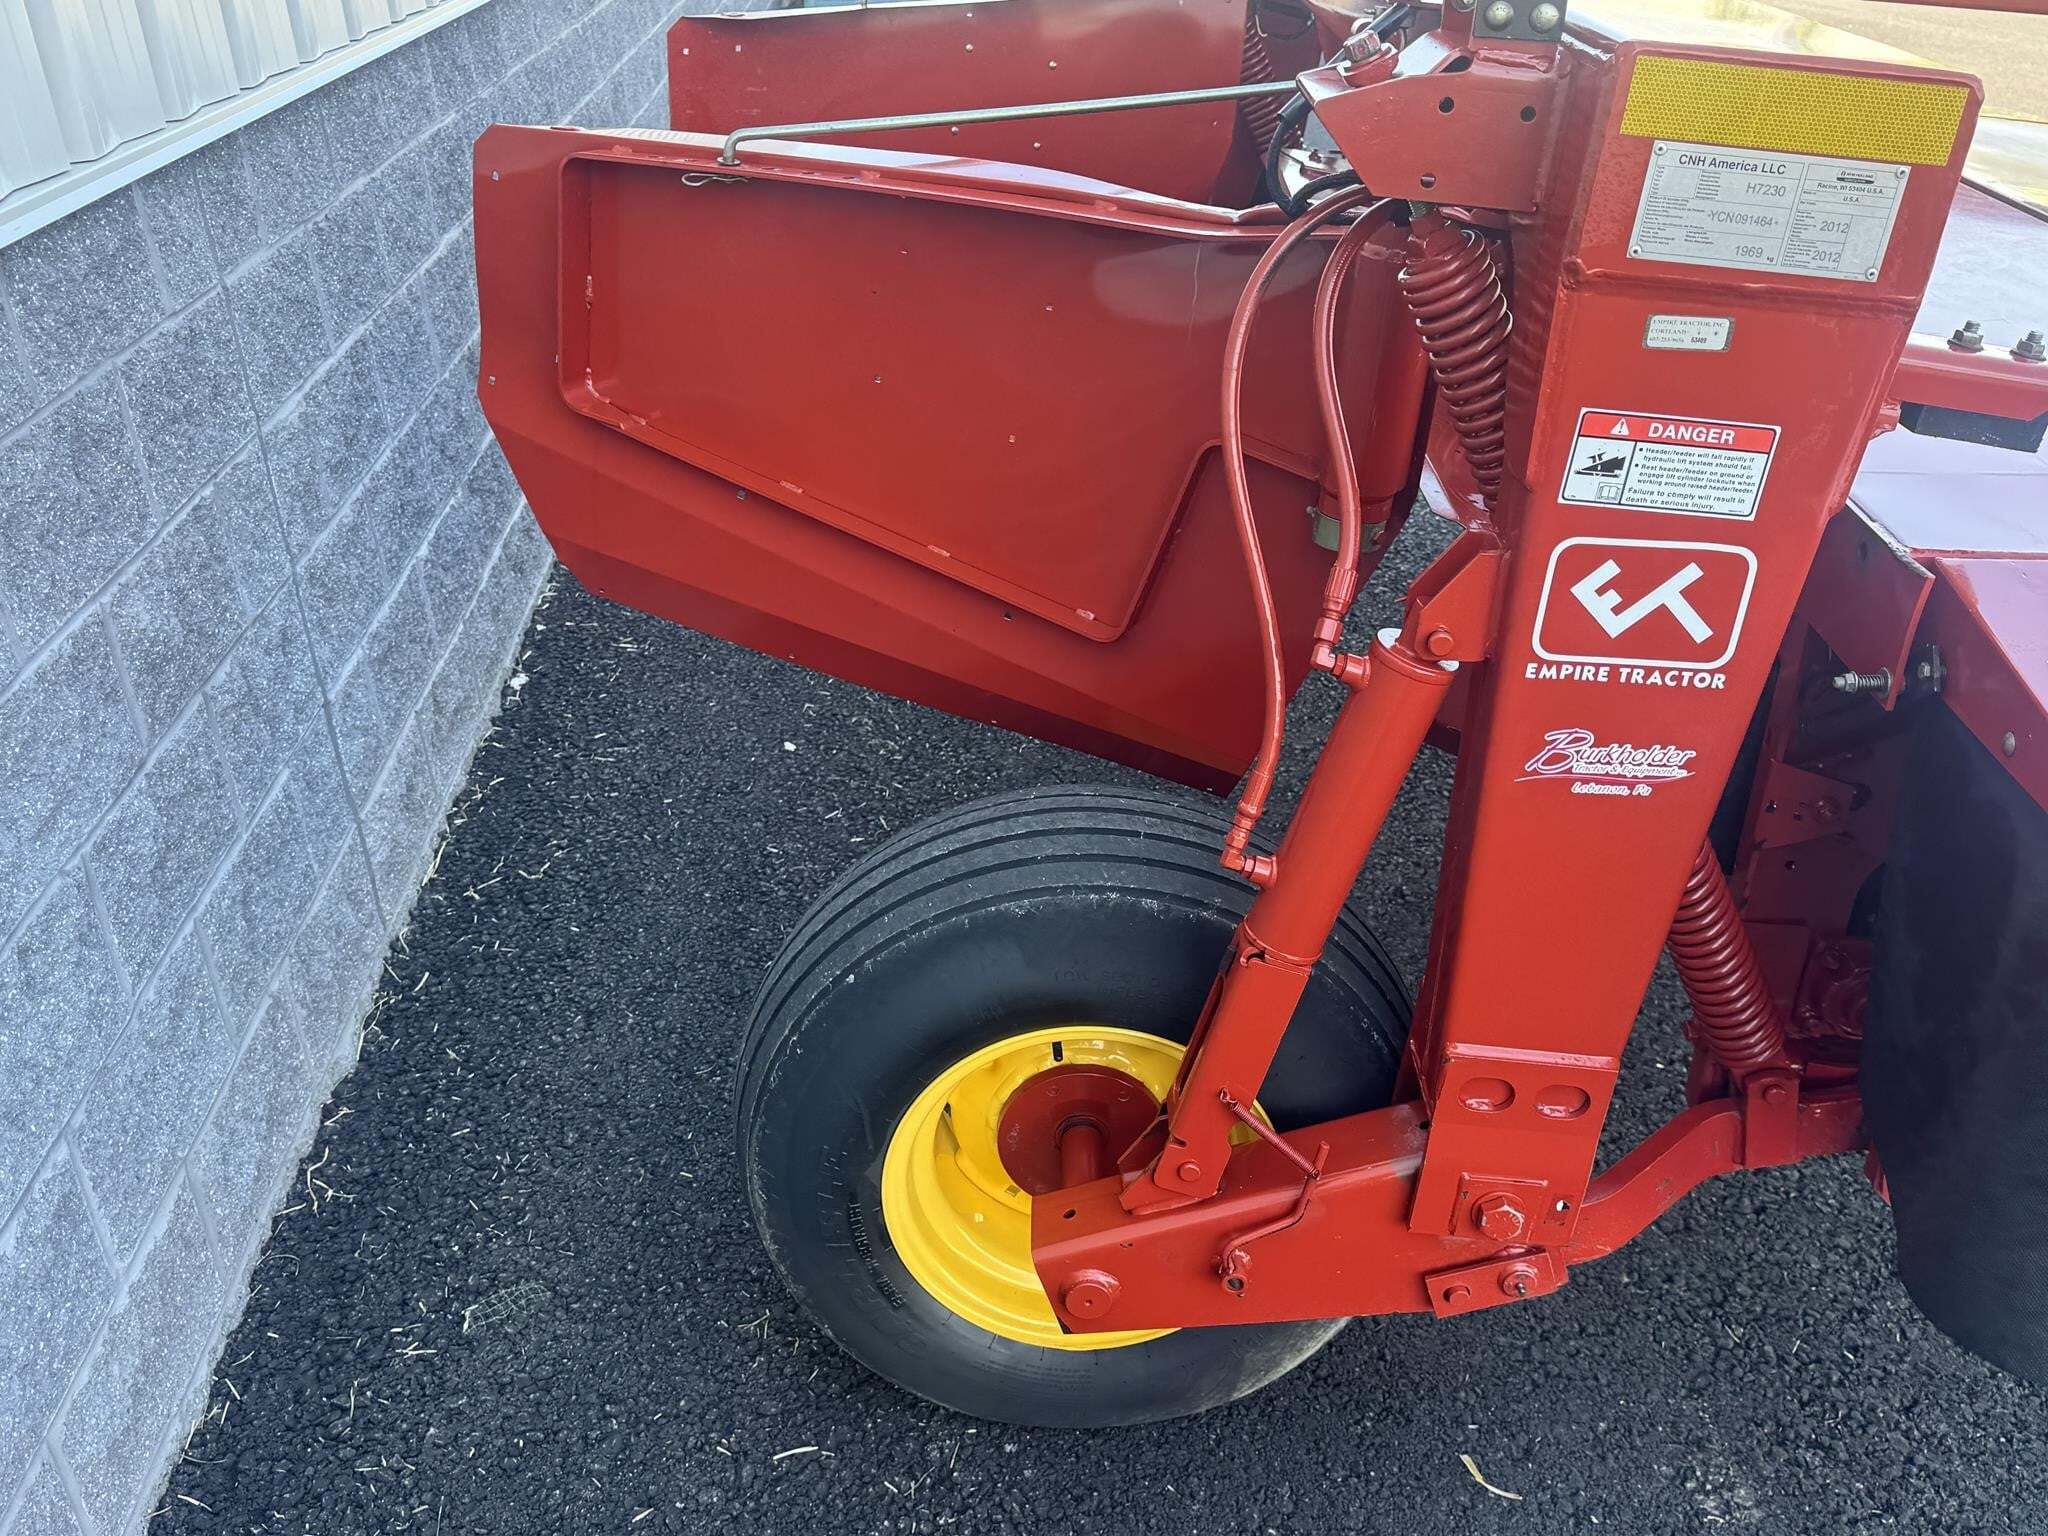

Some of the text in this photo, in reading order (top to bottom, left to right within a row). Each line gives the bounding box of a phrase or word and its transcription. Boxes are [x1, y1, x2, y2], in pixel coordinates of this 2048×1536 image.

[1679, 154, 1787, 175] CNH America LLC
[1746, 182, 1787, 198] H7230
[1819, 220, 1849, 234] 2012
[1734, 244, 1764, 259] 1969
[1811, 250, 1841, 263] 2012
[1648, 423, 1736, 445] DANGER
[1687, 460, 1713, 468] system
[1715, 461, 1738, 469] should
[1637, 478, 1662, 486] working
[1676, 475, 1705, 483] cylinder
[1719, 471, 1745, 479] ground
[1627, 487, 1655, 496] Failure
[1666, 491, 1696, 500] comply
[1697, 493, 1711, 501] will
[1713, 495, 1736, 503] result
[1737, 496, 1746, 504] in
[1625, 496, 1648, 504] death
[1660, 500, 1689, 508] serious
[1690, 501, 1716, 511] injury.
[1525, 663, 1726, 690] EMPIRE TRACTOR
[1525, 728, 1696, 773] Burkholder
[1573, 763, 1608, 774] Tractor
[1609, 763, 1620, 774] &
[1620, 764, 1677, 777] Equipment
[1571, 782, 1653, 796] Lebanon, Pa
